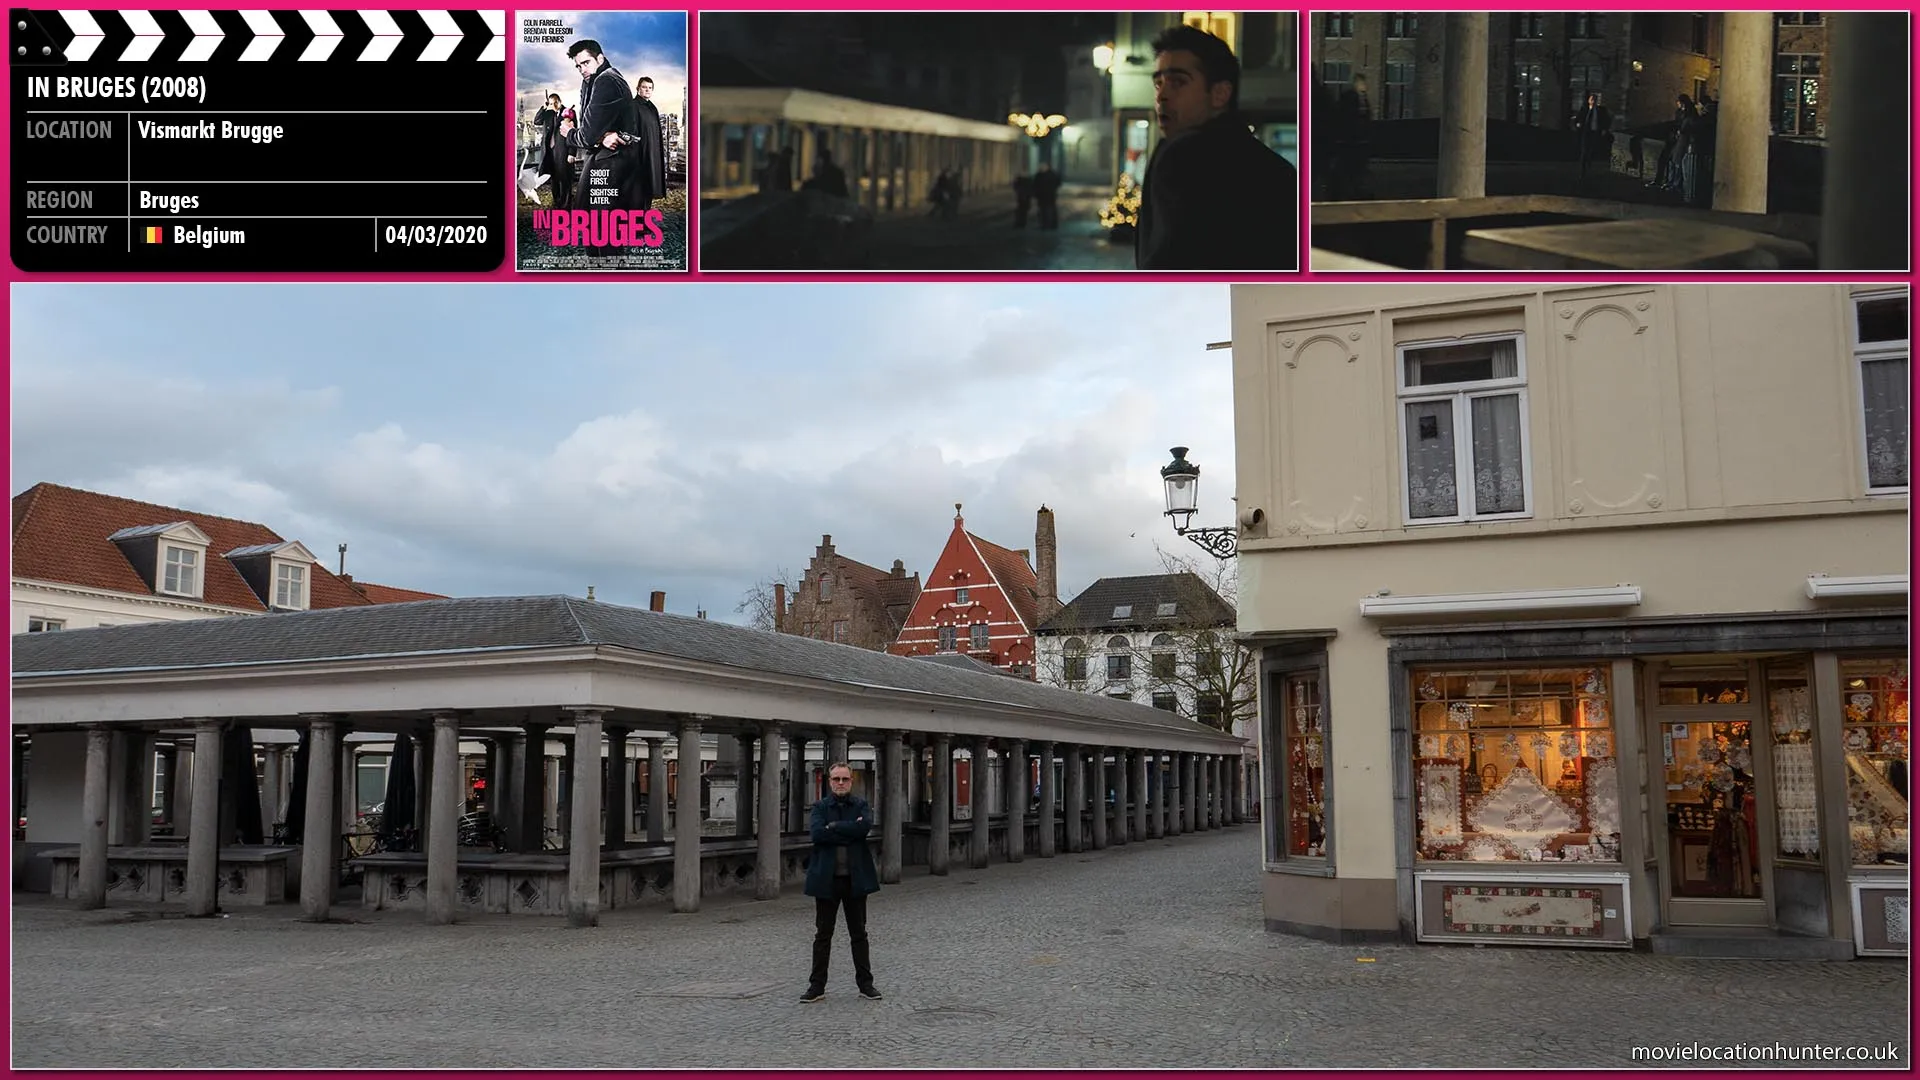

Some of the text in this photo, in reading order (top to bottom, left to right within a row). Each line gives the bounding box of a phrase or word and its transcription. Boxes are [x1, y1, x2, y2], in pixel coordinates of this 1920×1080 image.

[524, 19, 563, 27] COLIN FARRELL
[590, 169, 610, 177] SHOOT
[590, 177, 608, 185] FIRST.
[590, 188, 619, 196] SIGHTSEE
[590, 197, 610, 205] LATER.
[533, 209, 663, 247] IN BRUGES
